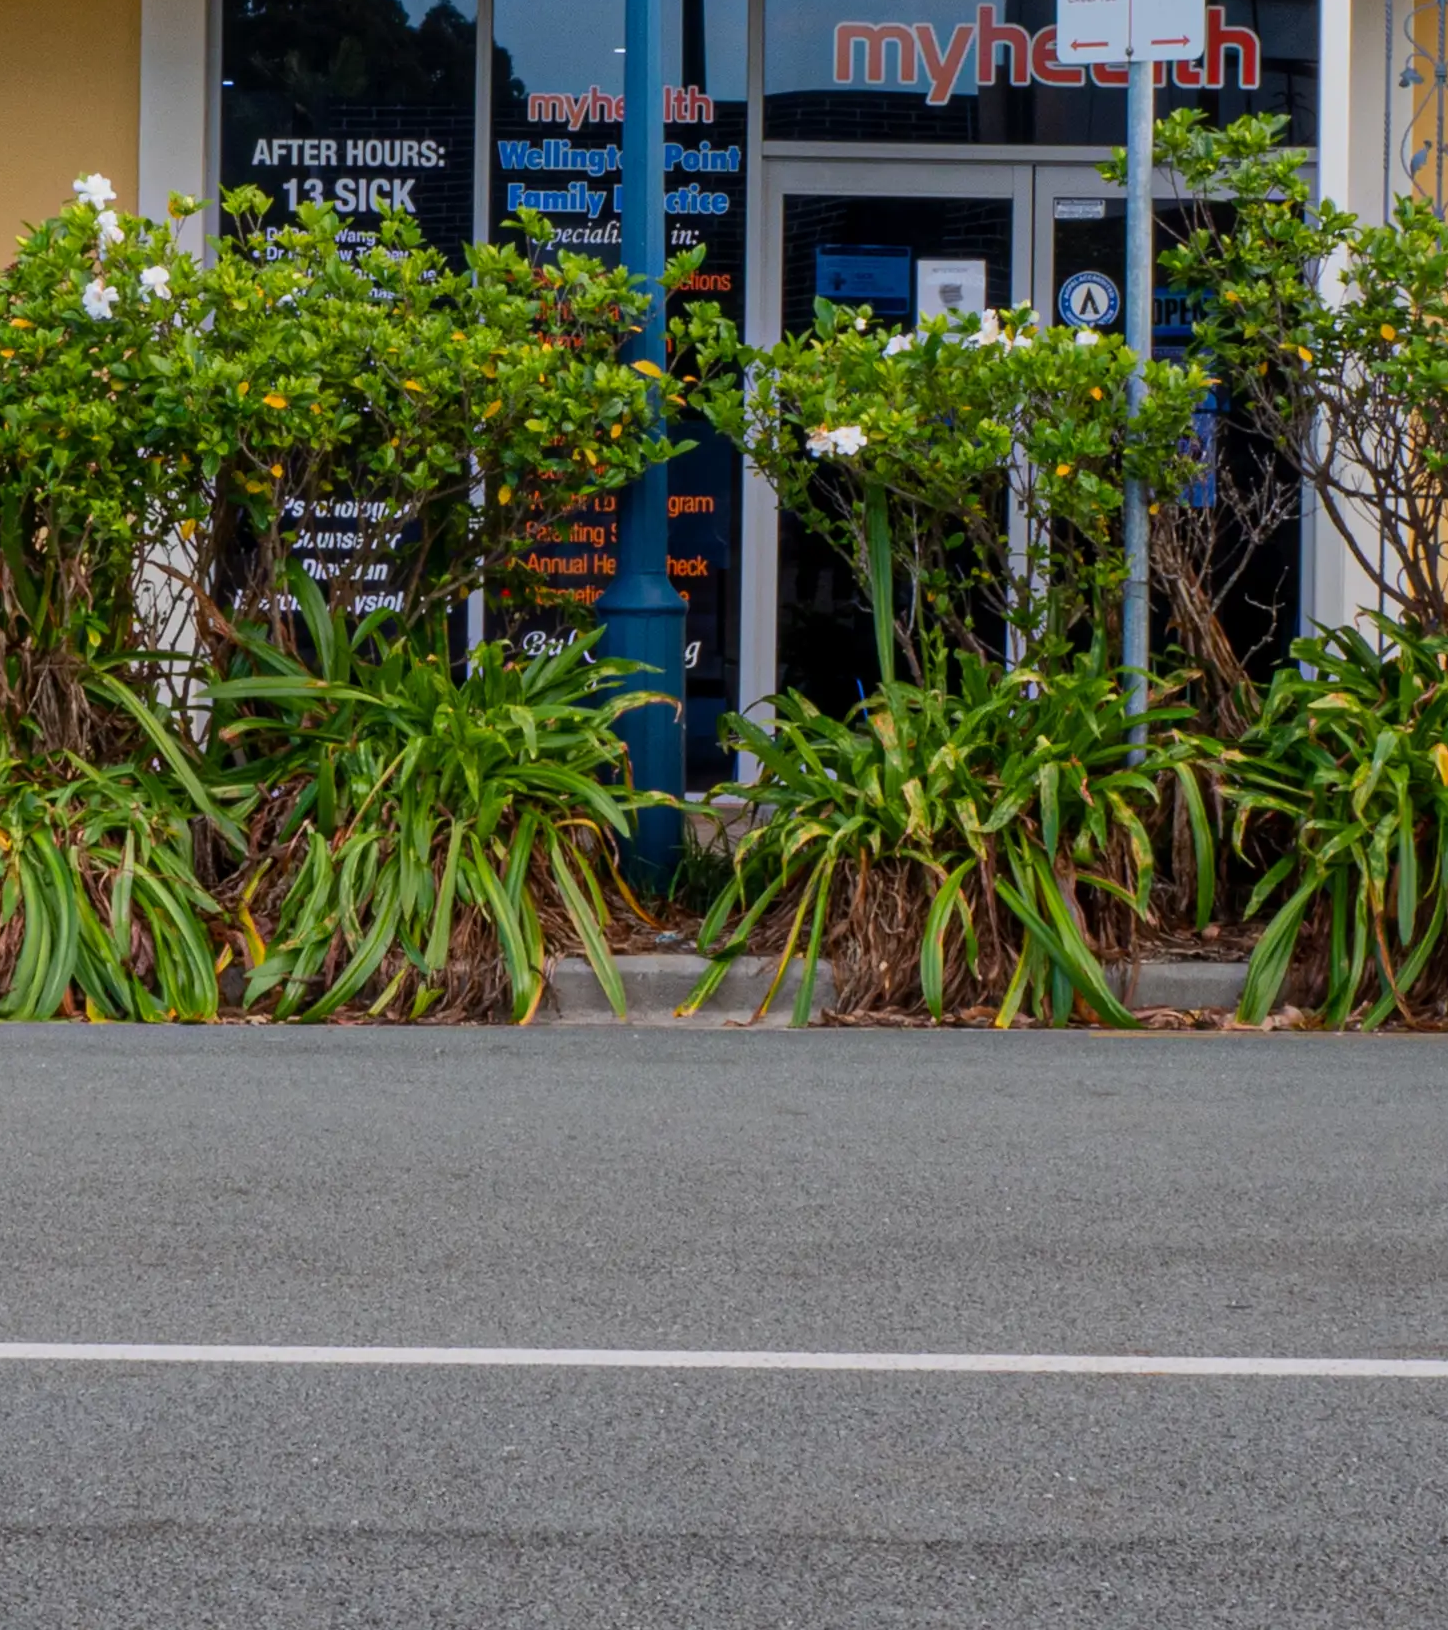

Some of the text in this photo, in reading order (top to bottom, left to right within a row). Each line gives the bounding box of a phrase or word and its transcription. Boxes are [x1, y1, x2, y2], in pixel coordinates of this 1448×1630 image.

[252, 139, 445, 167] AFTER HOURS:
[498, 139, 741, 176] Wellingt Point
[282, 178, 416, 213] 13 SICK
[508, 182, 607, 218] Family
[334, 228, 376, 246] Wang
[671, 223, 699, 245] in:
[266, 247, 284, 260] Dr
[527, 552, 588, 574] Annual
[666, 555, 709, 576] heck
